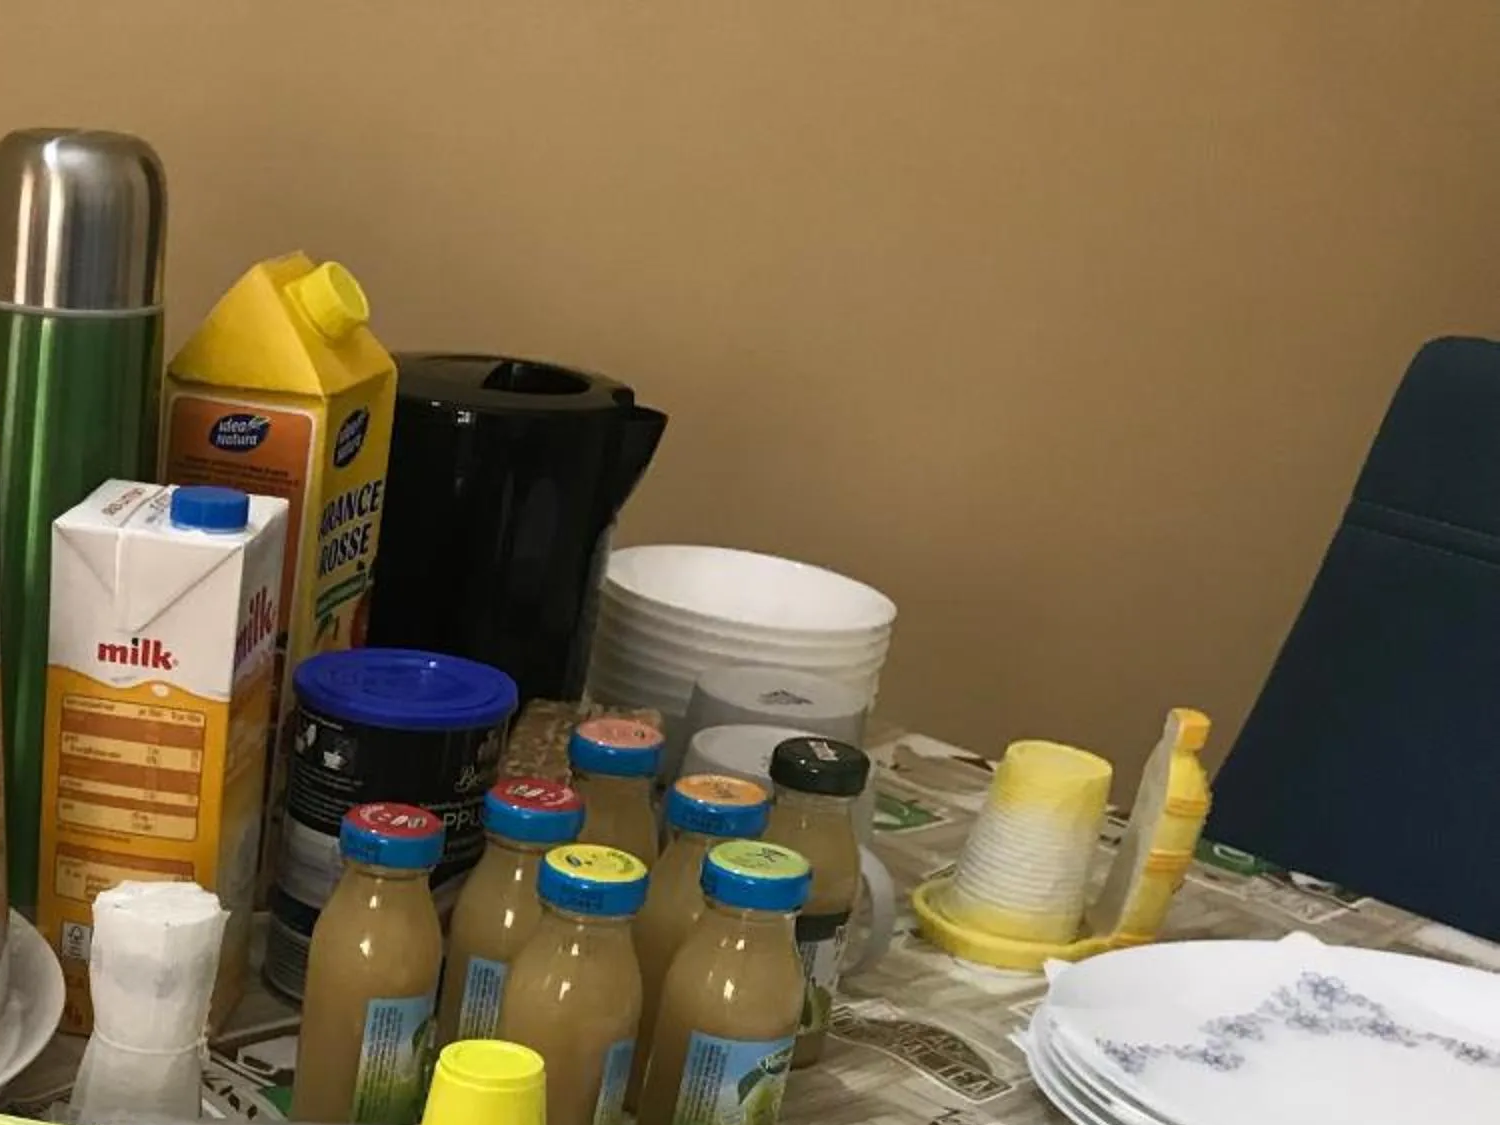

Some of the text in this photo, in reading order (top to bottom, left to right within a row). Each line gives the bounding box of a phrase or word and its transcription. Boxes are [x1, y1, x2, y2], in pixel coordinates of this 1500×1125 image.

[318, 479, 383, 541] ARANCE
[318, 522, 373, 578] ROSSE
[97, 637, 174, 671] milk
